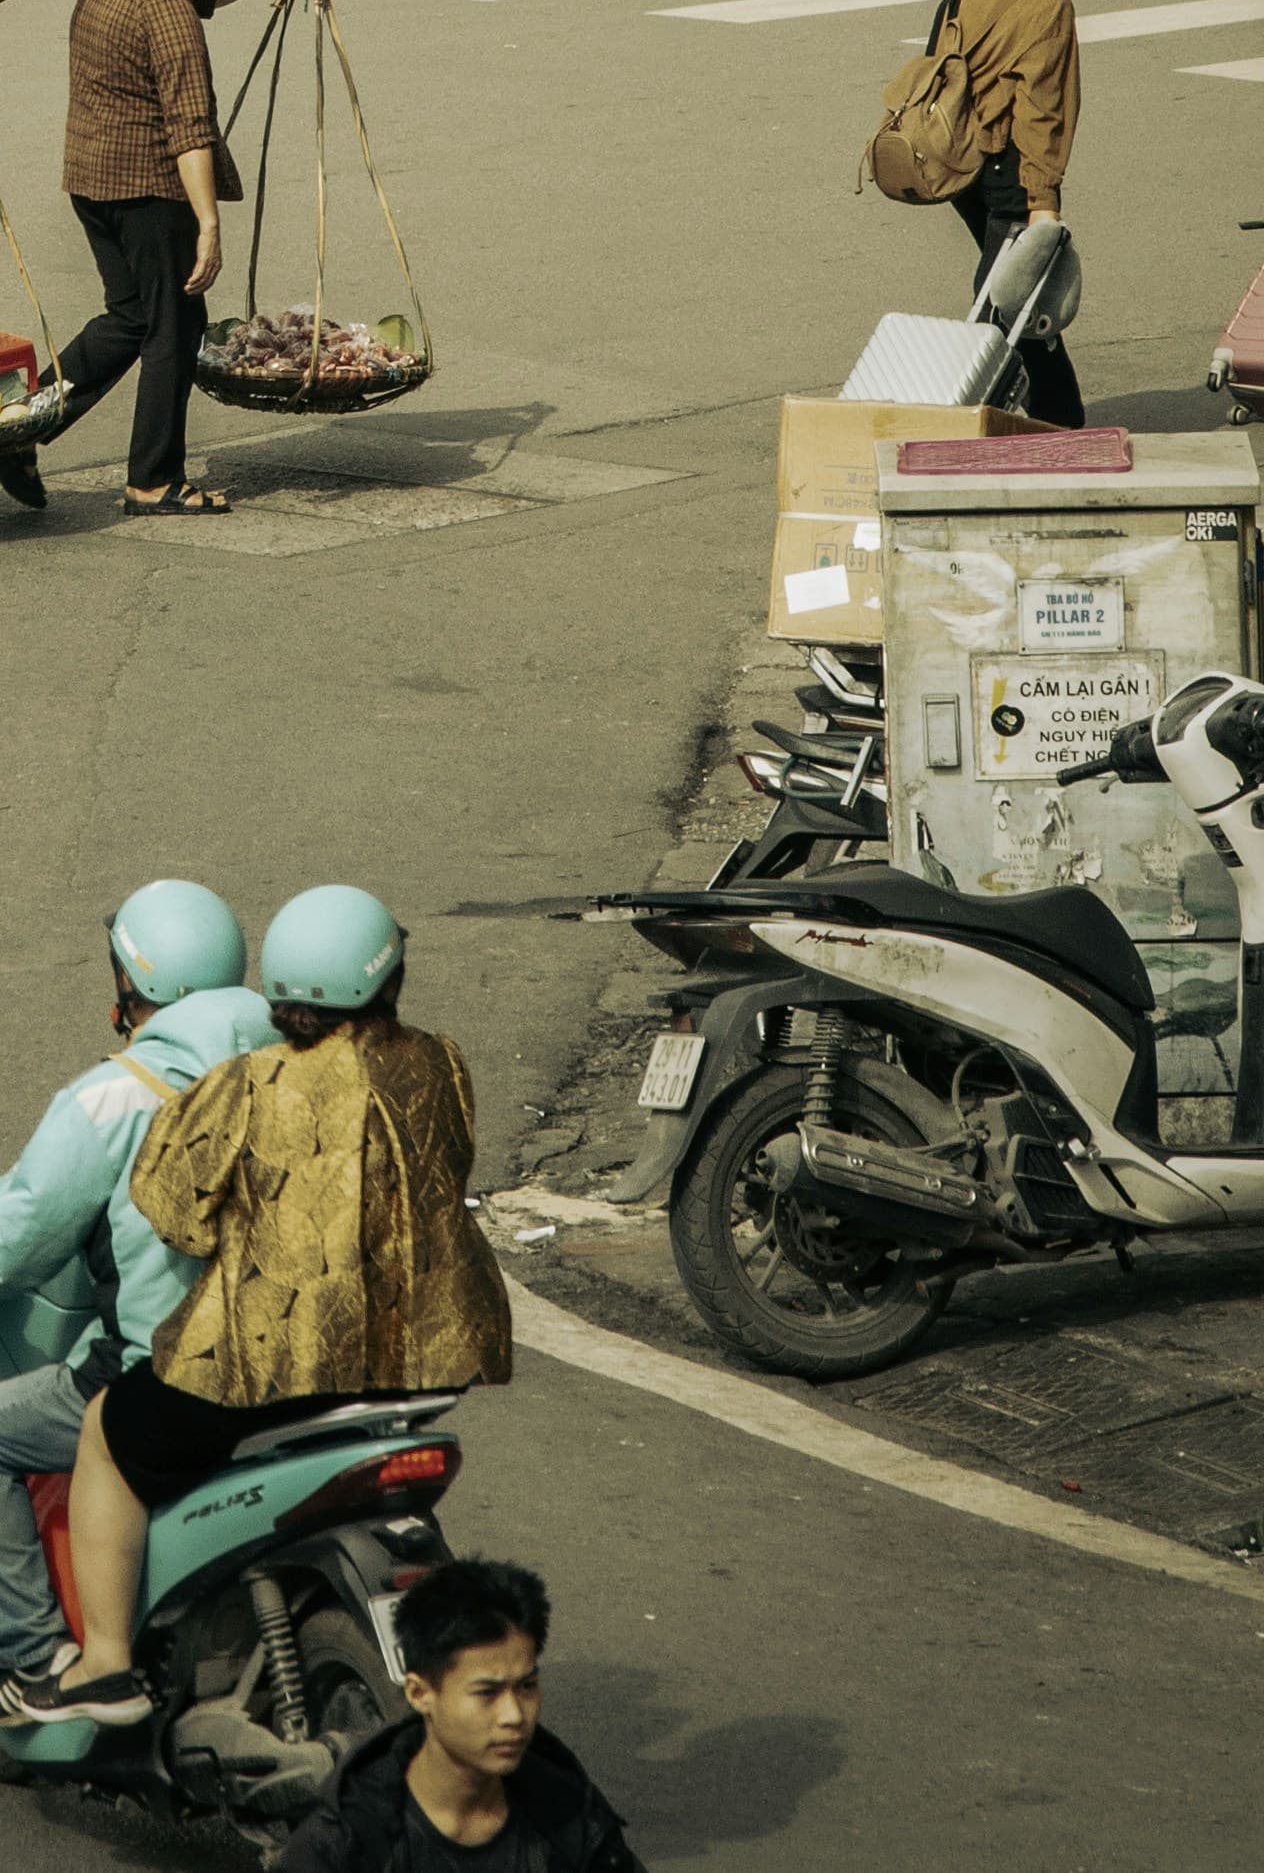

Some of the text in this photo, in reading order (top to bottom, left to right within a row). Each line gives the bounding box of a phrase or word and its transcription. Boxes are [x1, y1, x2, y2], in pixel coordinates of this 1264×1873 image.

[1187, 512, 1237, 526] AERGA
[1046, 594, 1063, 605] TBA
[1036, 609, 1105, 624] PILLAR 2
[1020, 676, 1060, 697] CẤM
[1066, 681, 1094, 699] LẠI
[1100, 674, 1139, 695] GẦN
[1081, 708, 1120, 724] ĐIỆN
[1040, 731, 1086, 742] NGUY
[1035, 746, 1079, 763] CHẾT
